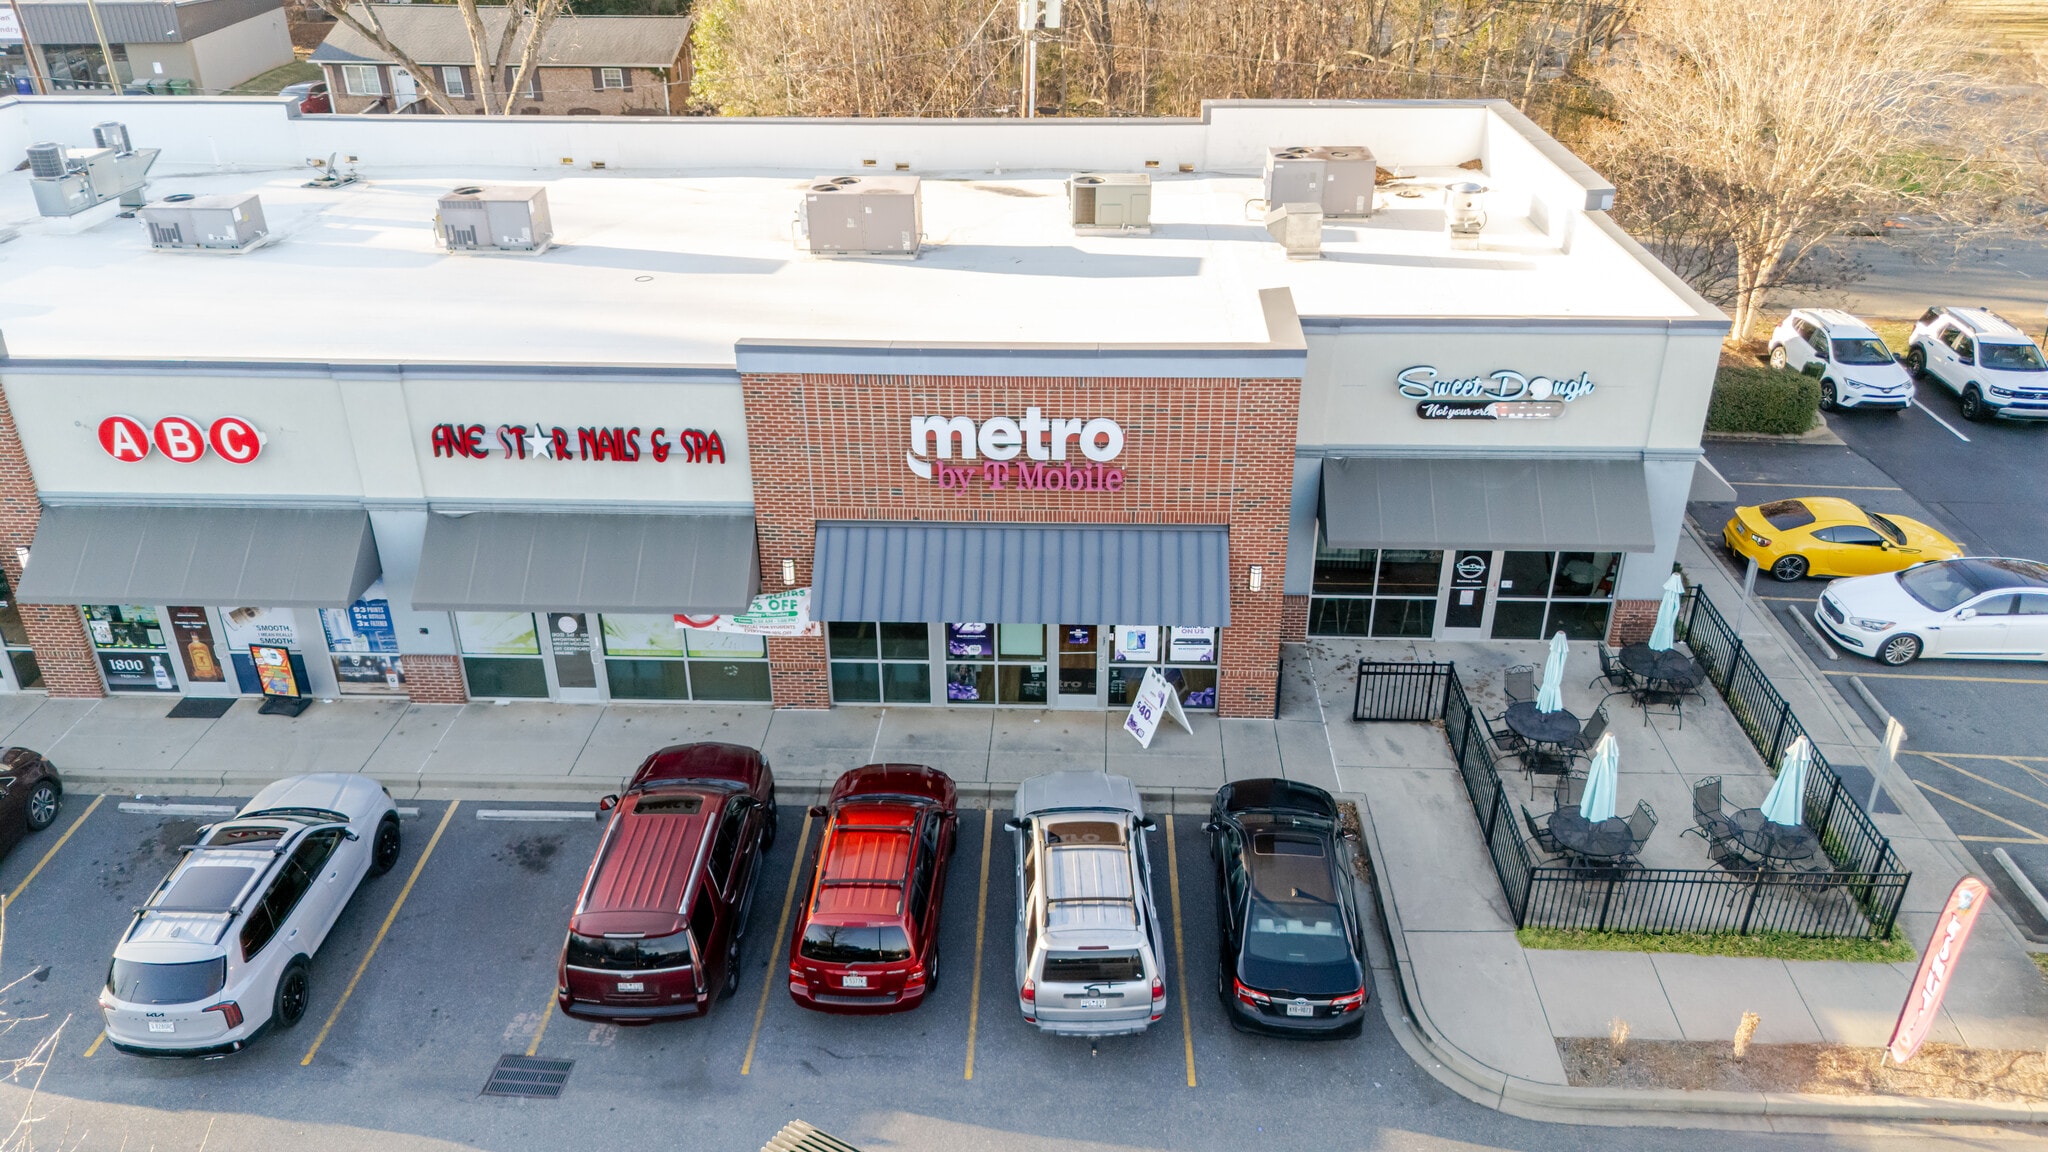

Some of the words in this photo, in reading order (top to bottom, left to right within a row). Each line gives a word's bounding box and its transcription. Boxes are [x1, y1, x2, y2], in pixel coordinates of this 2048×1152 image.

[1397, 365, 1484, 400] Sweet
[1421, 403, 1449, 417] Not
[1447, 407, 1473, 419] your
[578, 427, 640, 462] NAILS
[651, 427, 671, 463] &
[680, 428, 725, 464] SPA
[909, 407, 1124, 462] metro
[935, 460, 976, 496] by
[1016, 462, 1123, 491] Mobile
[768, 599, 798, 611] OFF
[109, 659, 144, 671] 1800
